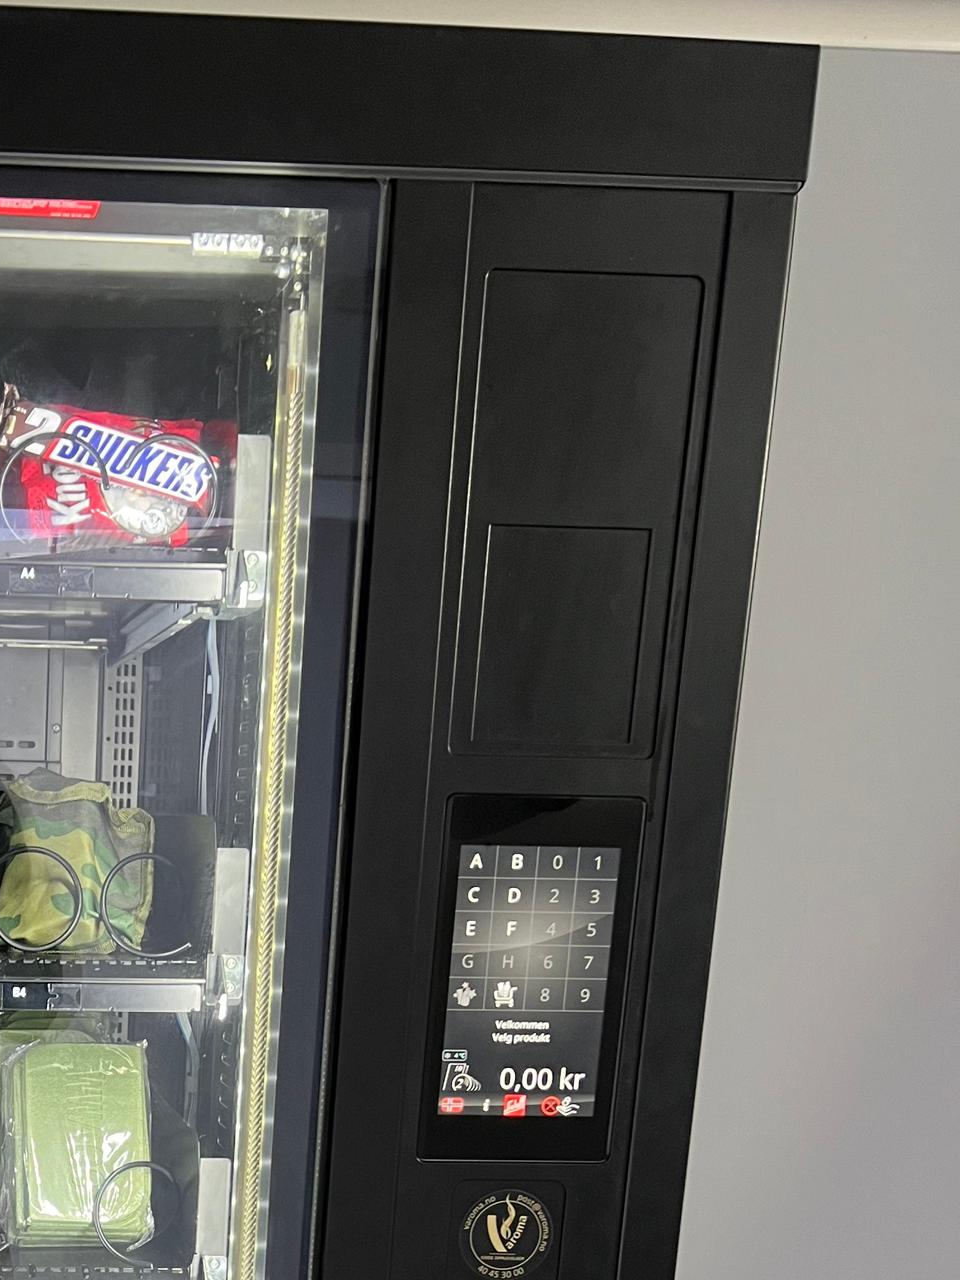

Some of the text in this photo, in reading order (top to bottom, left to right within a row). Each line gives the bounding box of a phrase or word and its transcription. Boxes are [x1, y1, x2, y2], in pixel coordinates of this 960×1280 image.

[20, 566, 35, 579] A4
[469, 853, 602, 870] A B 0 1
[467, 887, 601, 904] C D 2 3
[465, 920, 597, 937] E F 4 5
[462, 954, 594, 970] G H 6 7
[12, 986, 27, 998] B4
[539, 987, 591, 1003] 8 9
[495, 1019, 550, 1030] Velkommen
[492, 1032, 551, 1044] Velg produkt
[499, 1066, 586, 1092] 0,00 kr
[463, 1195, 497, 1230] varoma.no
[488, 1270, 500, 1279] 45
[501, 1270, 512, 1279] 30
